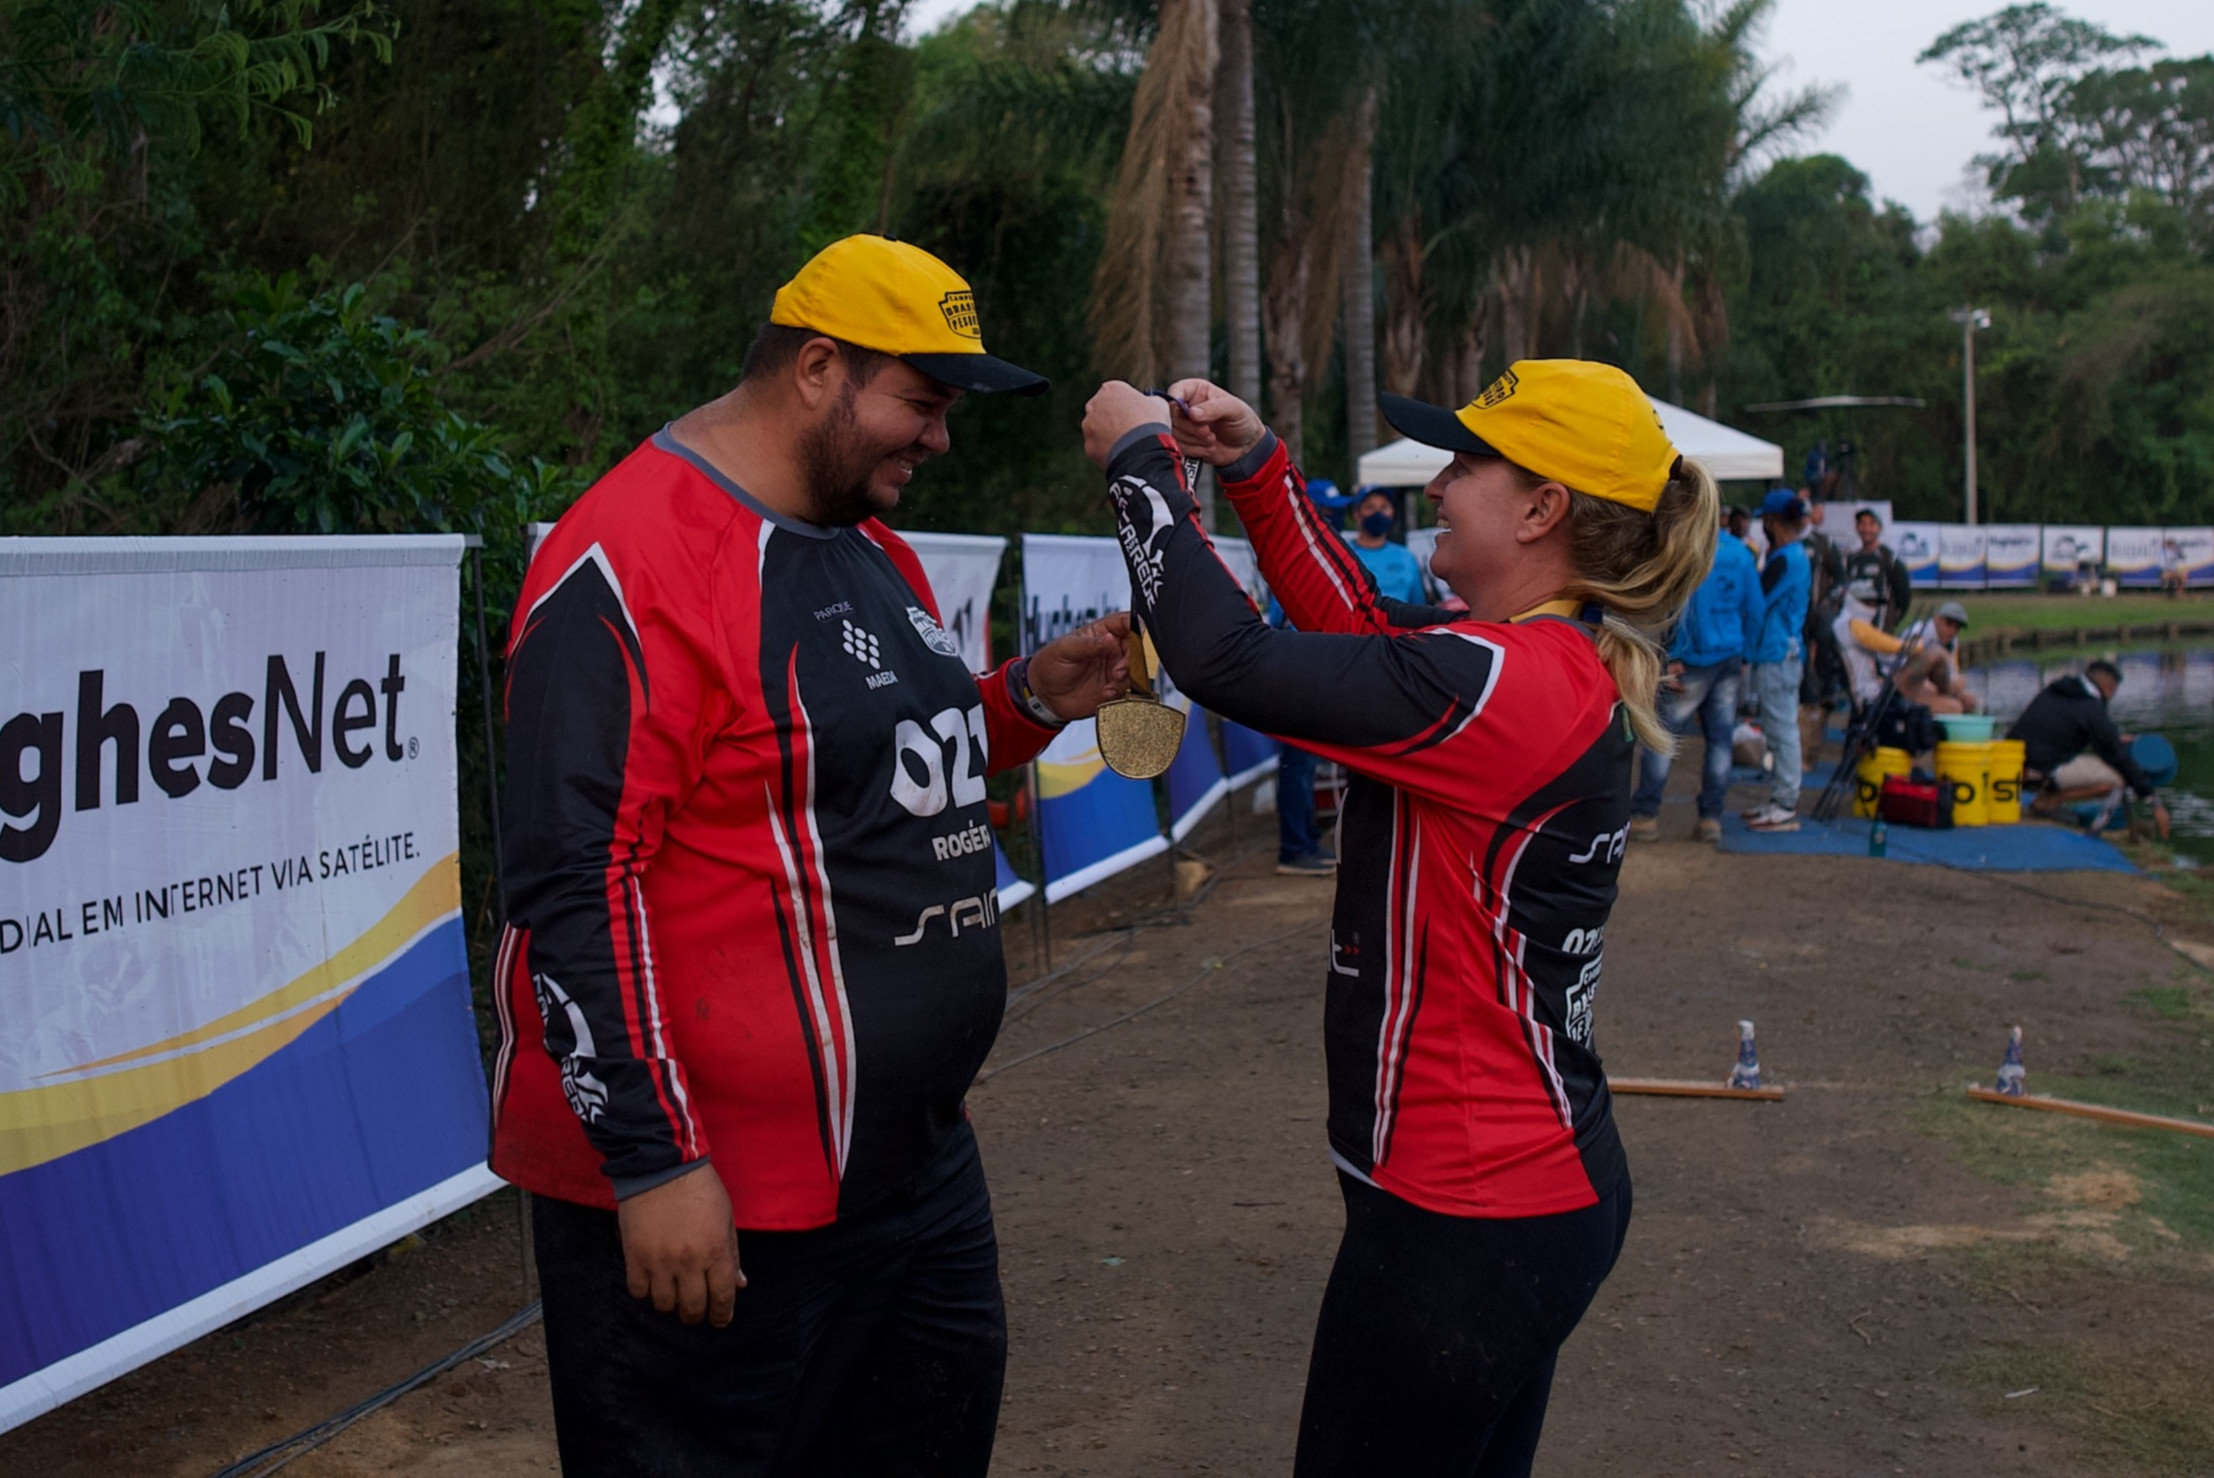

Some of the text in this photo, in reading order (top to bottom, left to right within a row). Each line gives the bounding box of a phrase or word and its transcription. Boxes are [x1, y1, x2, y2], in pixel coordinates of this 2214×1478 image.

[82, 895, 124, 935] EM
[135, 865, 263, 924] INTERNET
[271, 857, 314, 891] VIA
[319, 832, 420, 879] SATÉLITE.
